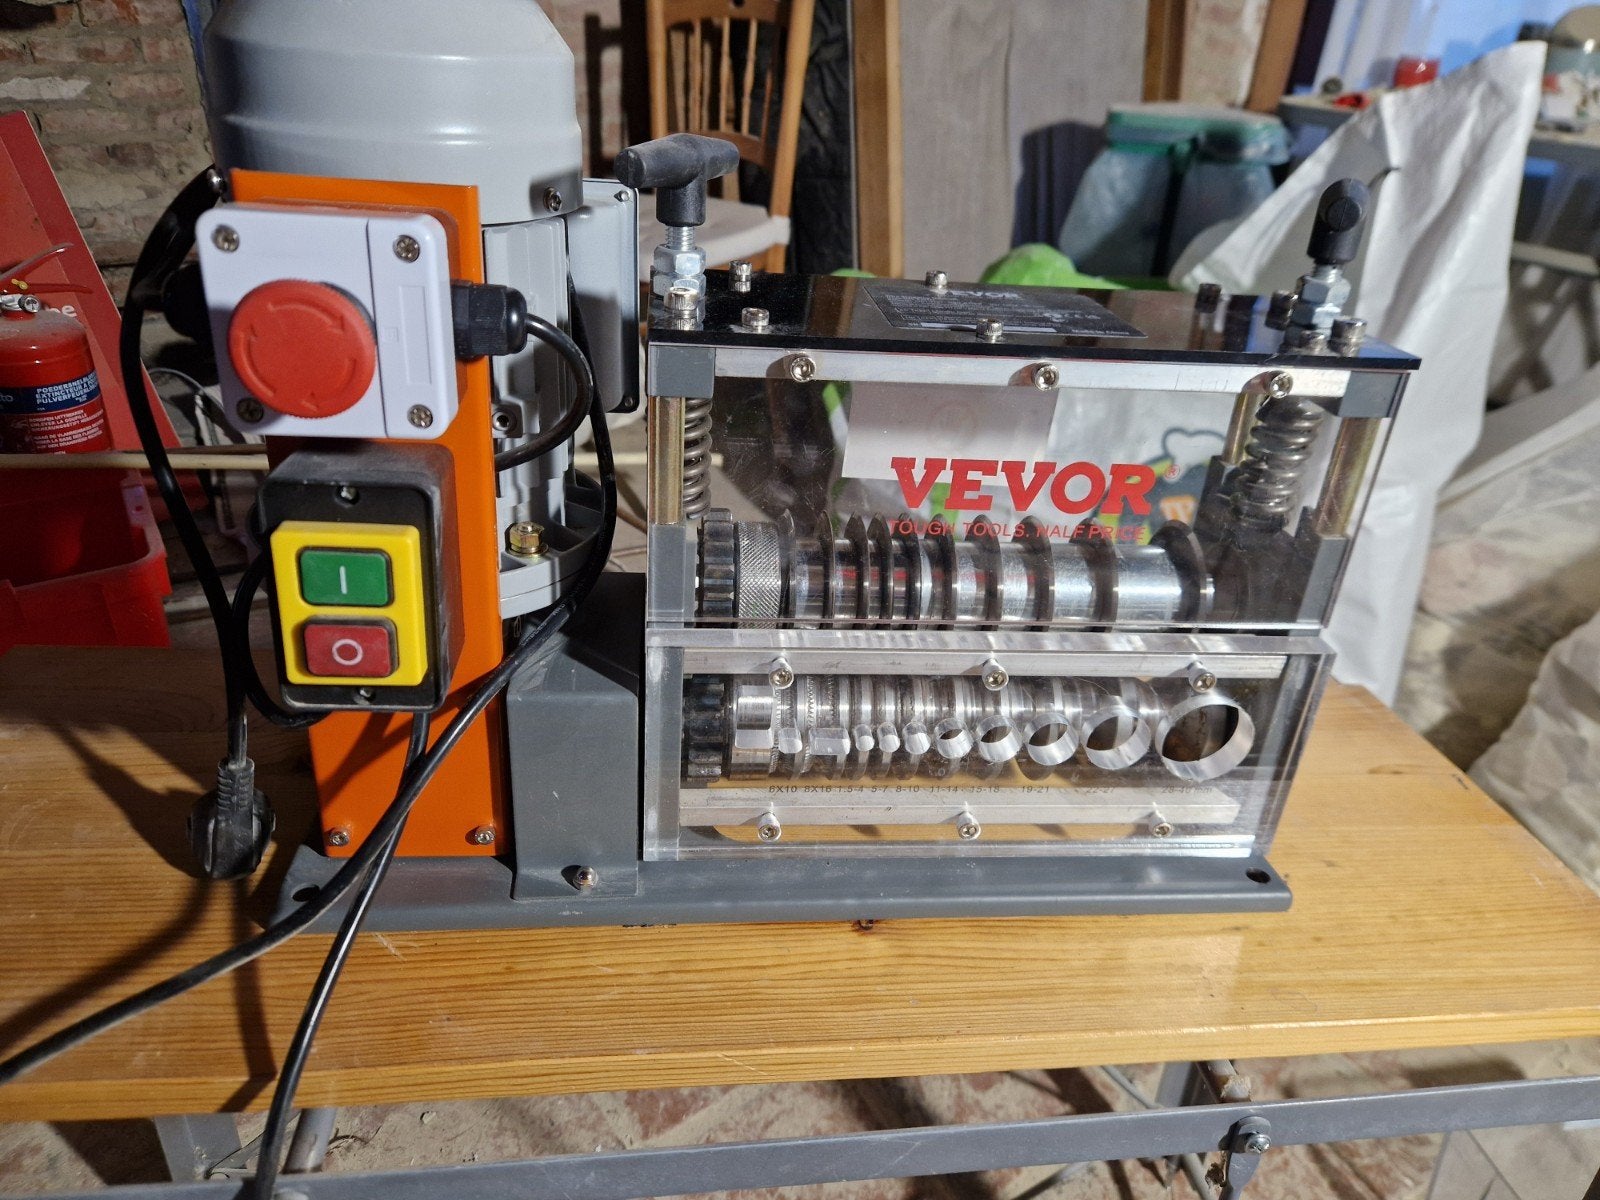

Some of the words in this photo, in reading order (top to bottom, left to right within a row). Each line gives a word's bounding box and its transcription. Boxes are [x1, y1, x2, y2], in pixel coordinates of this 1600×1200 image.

[890, 456, 1157, 515] VEVOR
[889, 519, 955, 536] TOUGH
[962, 520, 1030, 538] TOOLS.
[1036, 523, 1085, 539] HALF
[1087, 524, 1147, 541] PRICE
